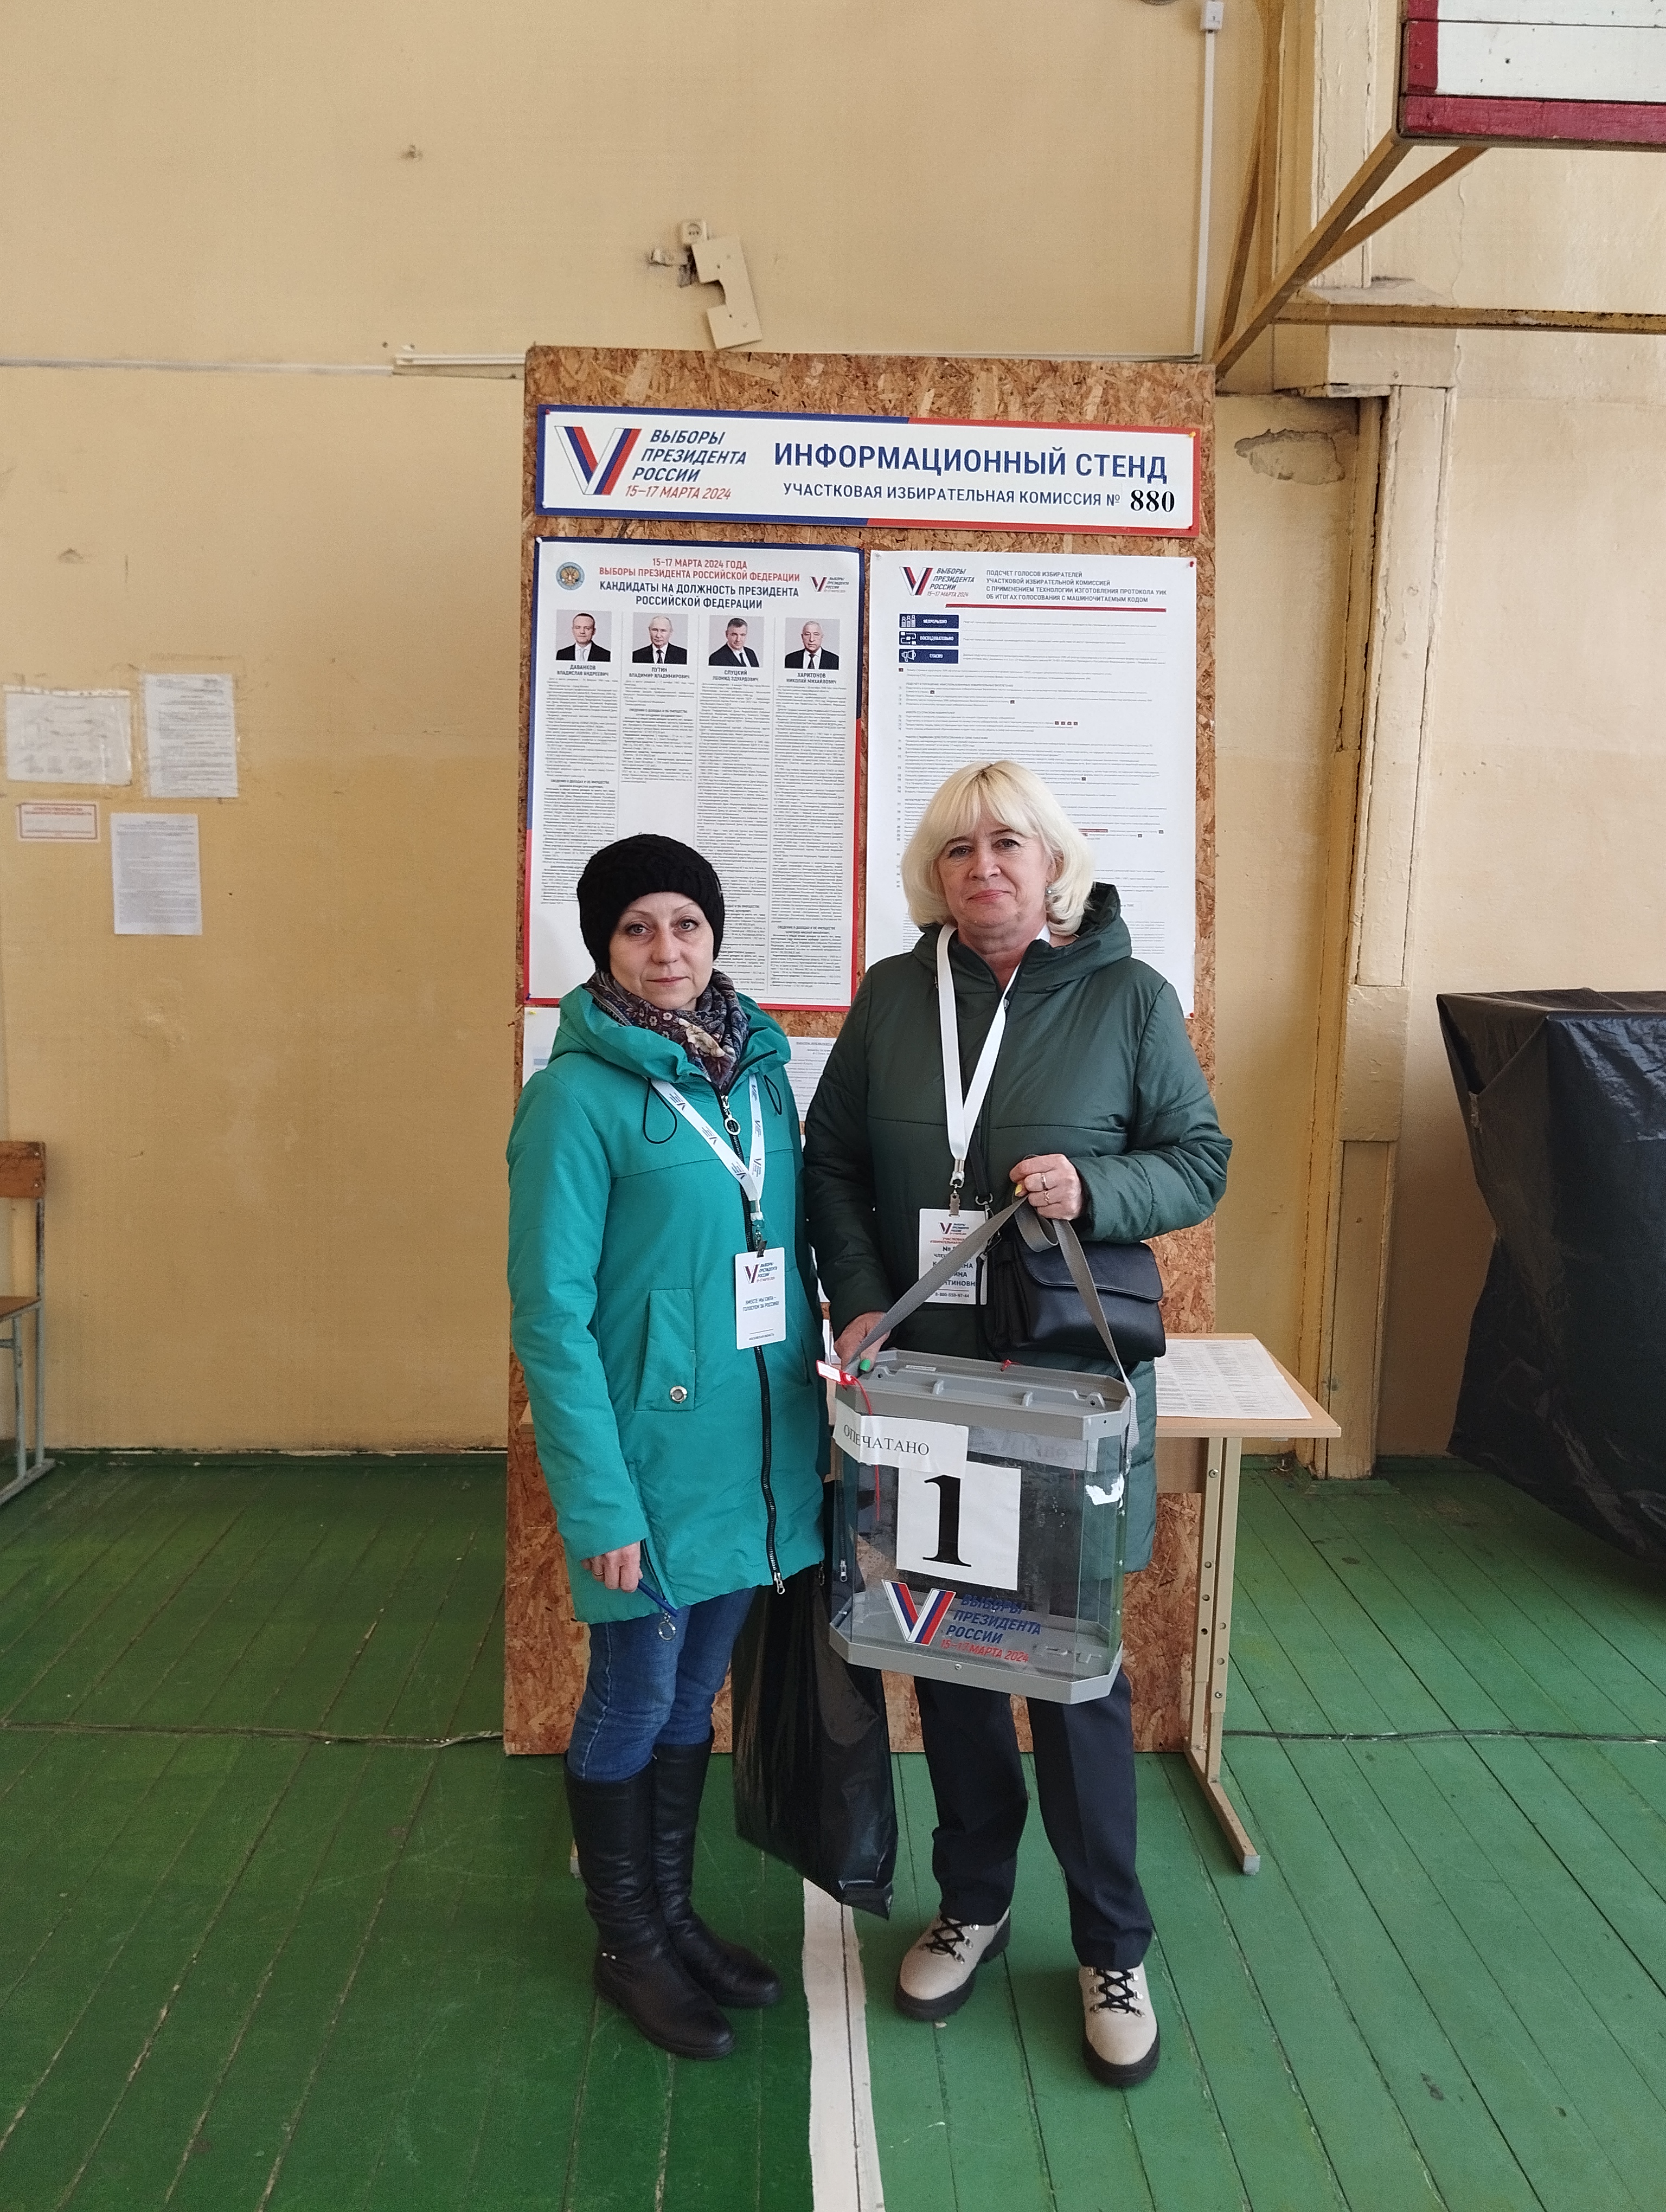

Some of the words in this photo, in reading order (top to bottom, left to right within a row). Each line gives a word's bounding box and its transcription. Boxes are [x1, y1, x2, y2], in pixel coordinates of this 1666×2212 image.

[649, 429, 726, 445] ВЫБОРЫ
[640, 448, 747, 466] ПРЕЗИДЕНТА
[774, 442, 1066, 476] ИНФОРМАЦИОННЫЙ
[1076, 453, 1168, 484] СТЕНД
[631, 467, 701, 483] РОССИИ
[659, 487, 701, 499] МАРТА
[702, 487, 732, 500] 2024
[783, 483, 882, 499] УЧАСТКОВАЯ
[887, 486, 1015, 503] ИЗБИРАТЕЛЬНАЯ
[1020, 491, 1101, 506] КОМИССИЯ
[1106, 493, 1120, 506] №
[1130, 489, 1175, 512] 880
[675, 558, 702, 568] МАРТА
[704, 560, 724, 568] 2024
[726, 560, 747, 570] ГОДА
[599, 567, 636, 576] ВЫБОРЫ
[638, 568, 691, 579] ПРЕЗИДЕНТА
[693, 569, 748, 580] РОССИЙСКОЙ
[749, 571, 800, 582] ФЕДЕРАЦИИ
[932, 575, 975, 583] ПРЕЗИДЕНТА
[599, 581, 659, 593] КАНДИДАТЫ
[662, 583, 674, 593] НА
[676, 584, 736, 595] ДОЛЖНОСТЬ
[738, 586, 799, 597] ПРЕЗИДЕНТА
[636, 595, 701, 607] РОССИЙСКОЙ
[703, 597, 762, 610] ФЕДЕРАЦИИ
[843, 1424, 930, 1456] ОПЕЧАТАНО
[922, 1474, 972, 1568] 1
[961, 1593, 1025, 1615] ВЫБОРЫ
[953, 1610, 1042, 1635] ПРЕЗИДЕНТА
[946, 1624, 1004, 1644] РОССИИ
[969, 1643, 1004, 1658] МАРТА
[1004, 1650, 1030, 1663] 2024
